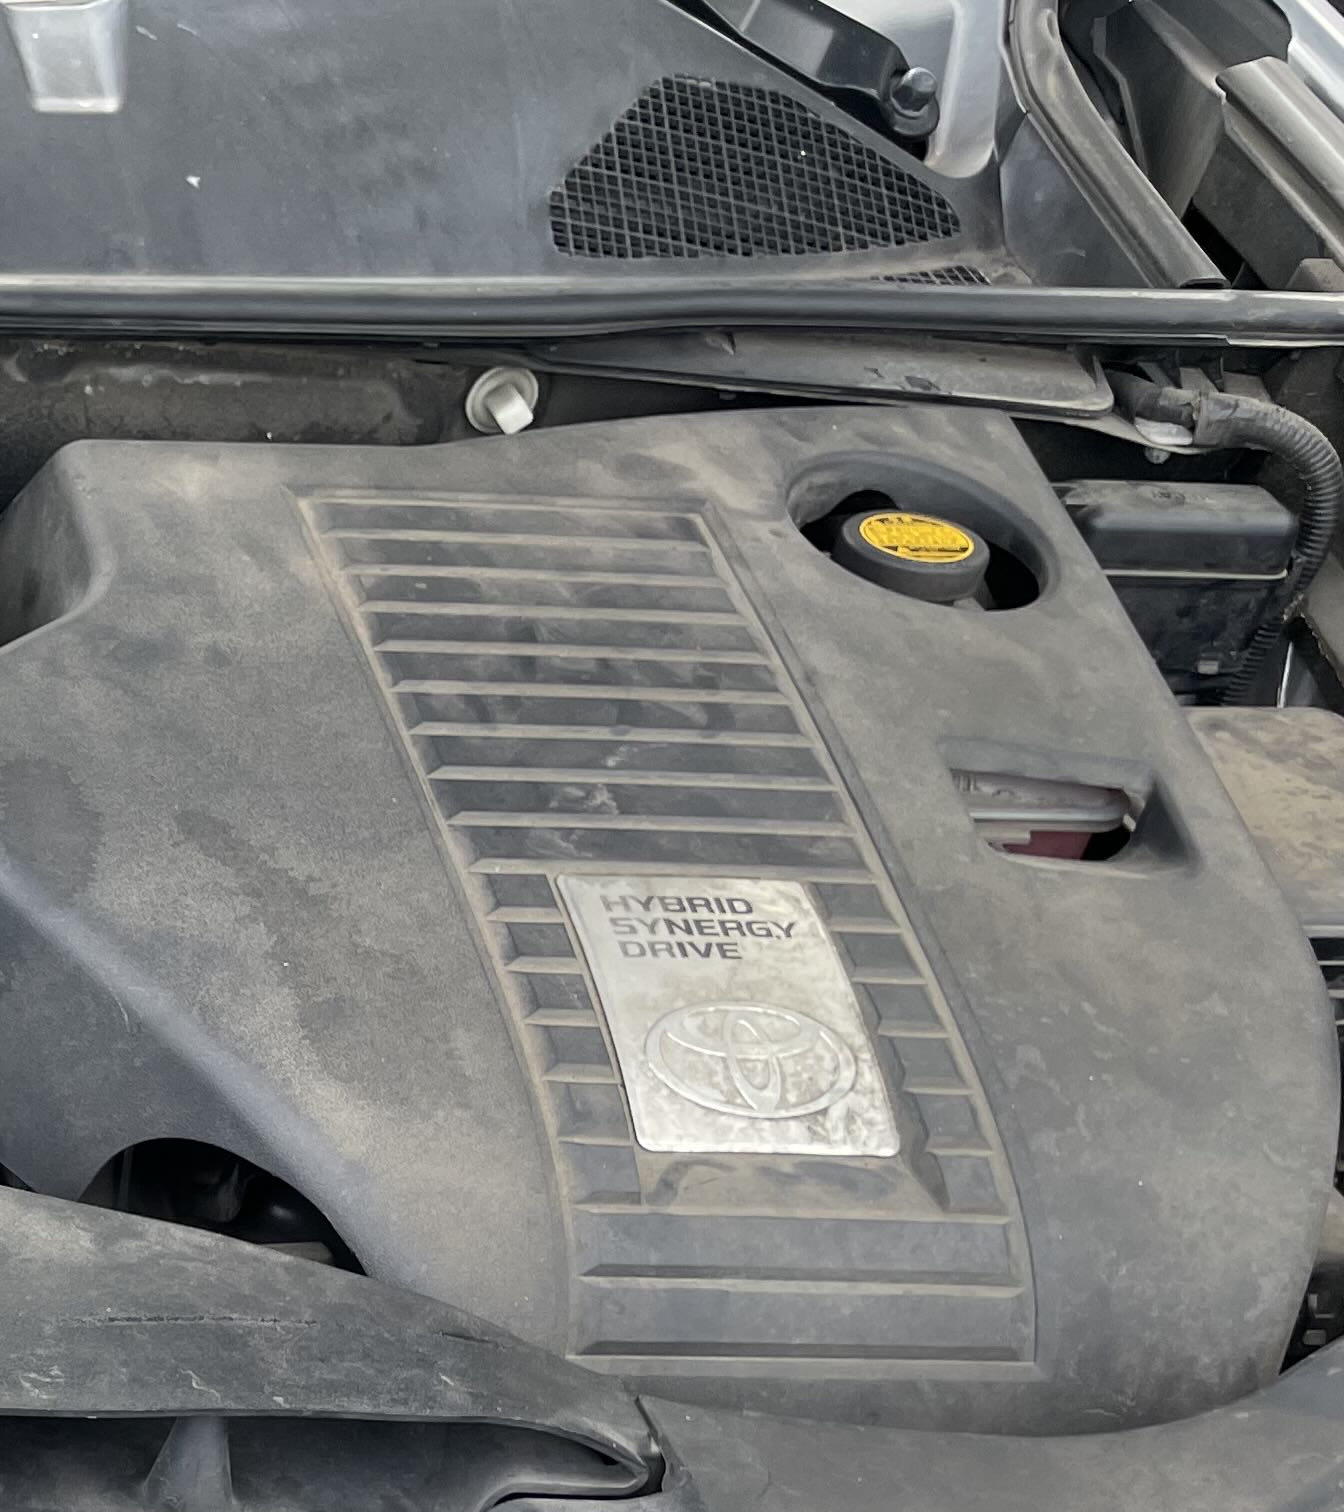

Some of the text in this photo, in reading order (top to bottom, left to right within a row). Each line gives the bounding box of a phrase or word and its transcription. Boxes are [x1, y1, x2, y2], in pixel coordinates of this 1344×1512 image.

[601, 895, 754, 915] HYBRID
[610, 917, 796, 940] SYNERGY
[621, 940, 743, 960] DRIVE
